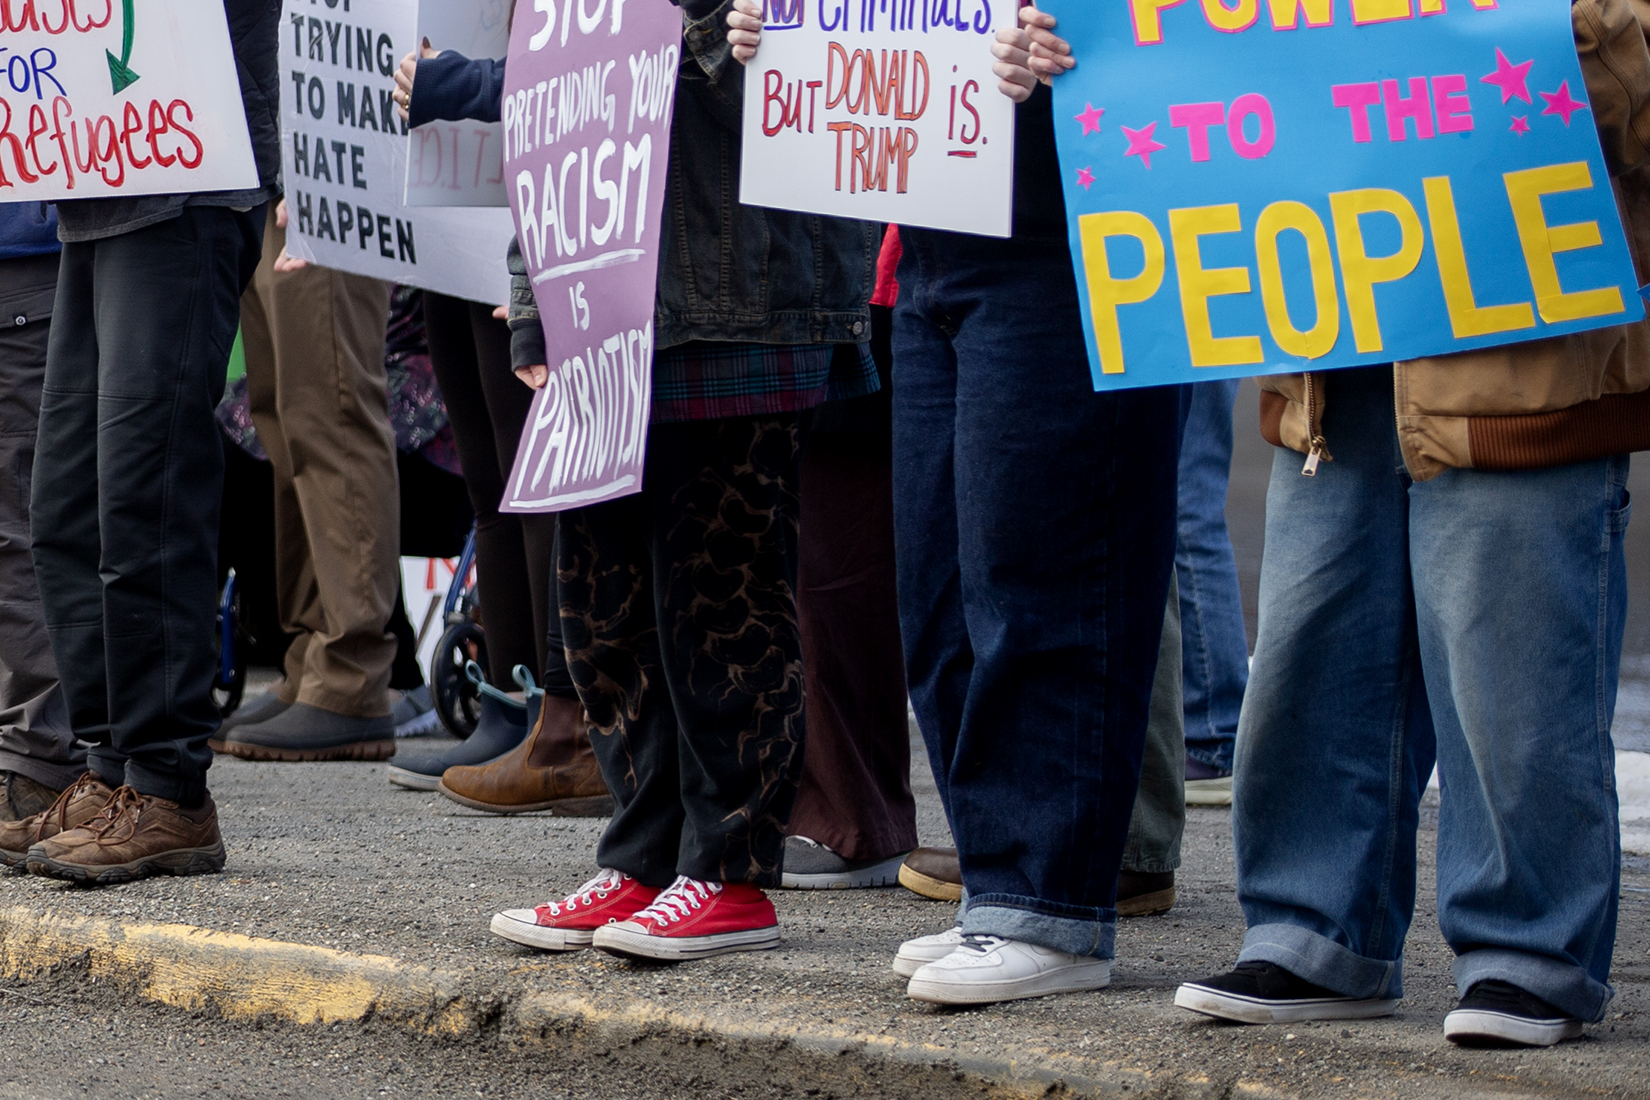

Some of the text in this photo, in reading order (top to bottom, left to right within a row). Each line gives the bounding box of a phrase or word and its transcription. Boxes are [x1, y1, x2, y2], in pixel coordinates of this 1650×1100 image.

[290, 13, 394, 78] TRYING
[826, 41, 930, 120] DONALD
[292, 71, 409, 137] TO MAK
[503, 43, 678, 163] PRETENDING YOUR
[1169, 74, 1474, 162] TO THE
[293, 132, 368, 190] HATE
[827, 121, 919, 194] TRUMP
[296, 189, 417, 265] HAPPEN
[517, 133, 651, 269] RACISM
[569, 281, 589, 330] IS
[1078, 160, 1625, 374] PEOPLE
[514, 318, 651, 500] PATRIOTISM
